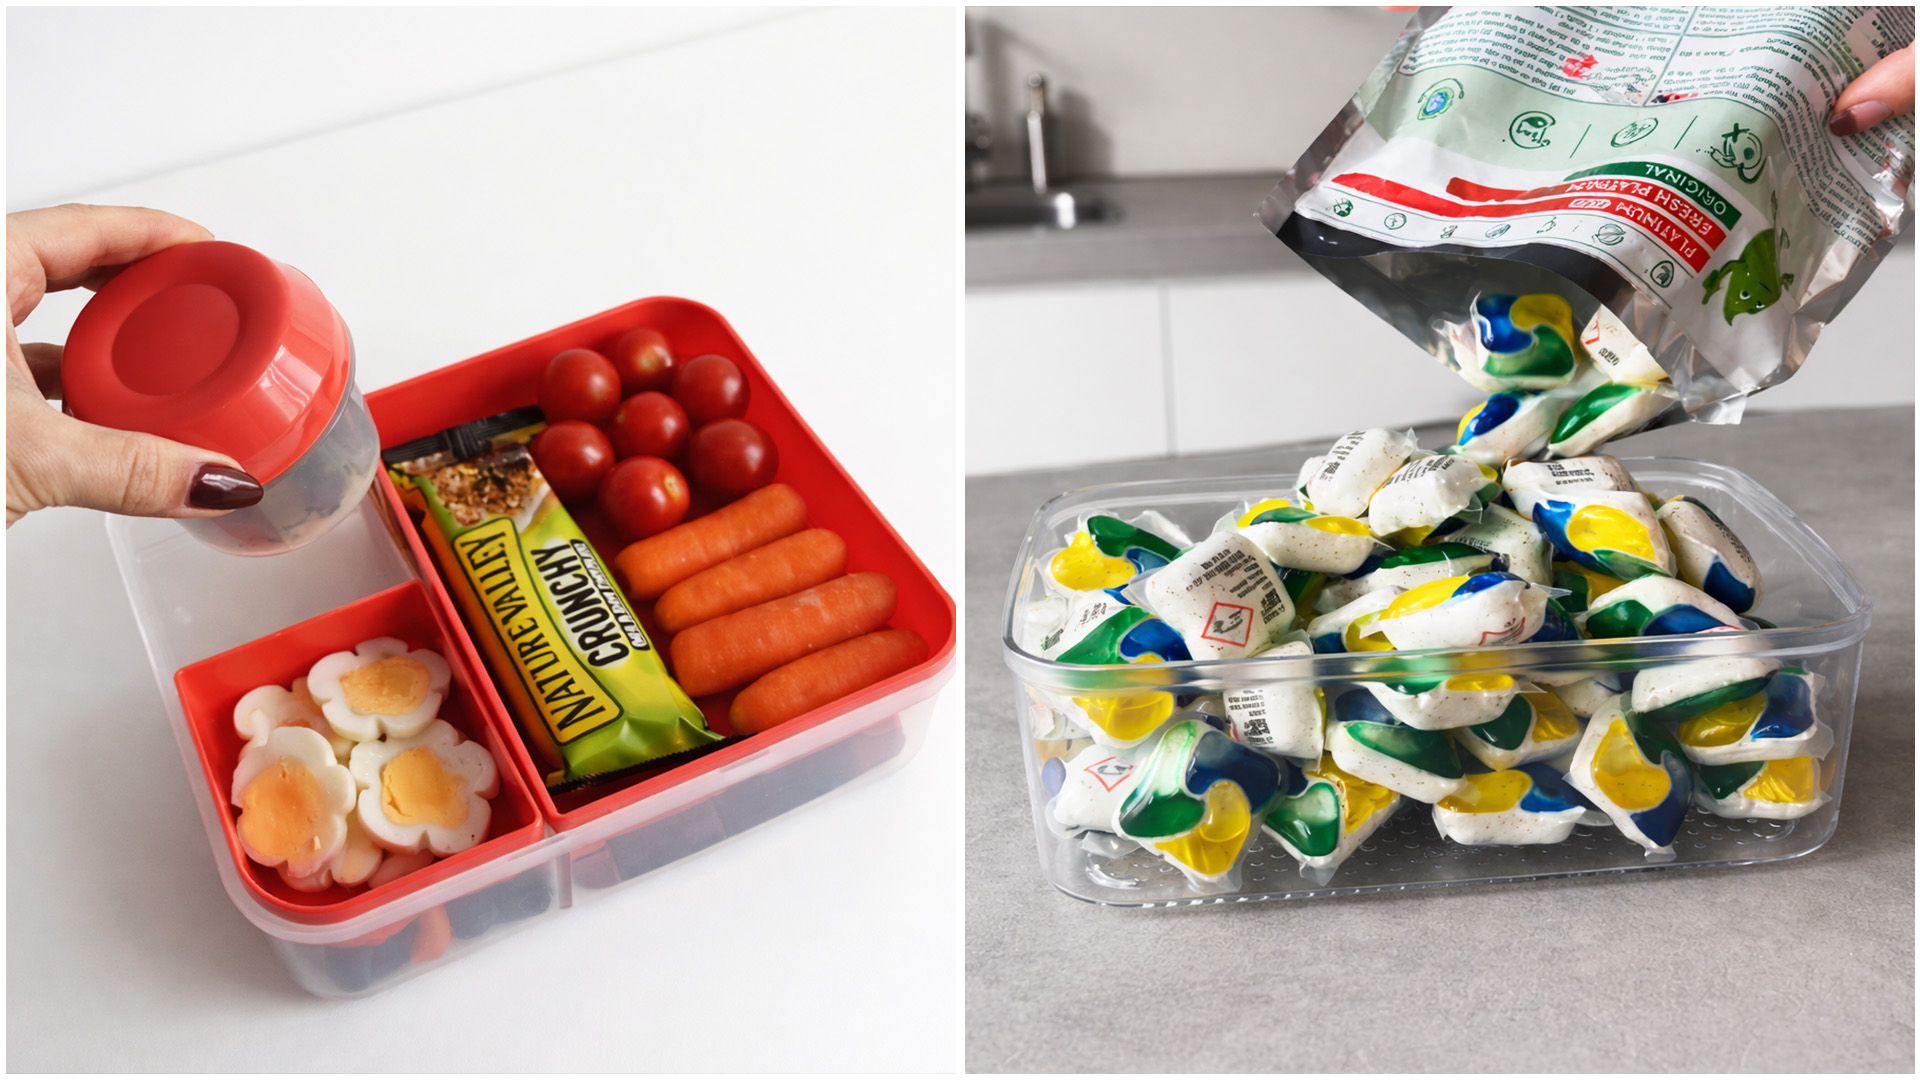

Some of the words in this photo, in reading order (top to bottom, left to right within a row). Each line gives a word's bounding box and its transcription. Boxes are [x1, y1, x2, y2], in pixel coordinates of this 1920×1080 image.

[1615, 202, 1698, 259] PLATINUM
[1645, 163, 1727, 216] ORIGINAL
[460, 531, 529, 627] VALLEY
[530, 543, 631, 668] CRUNCHY
[506, 616, 607, 733] NATURE
